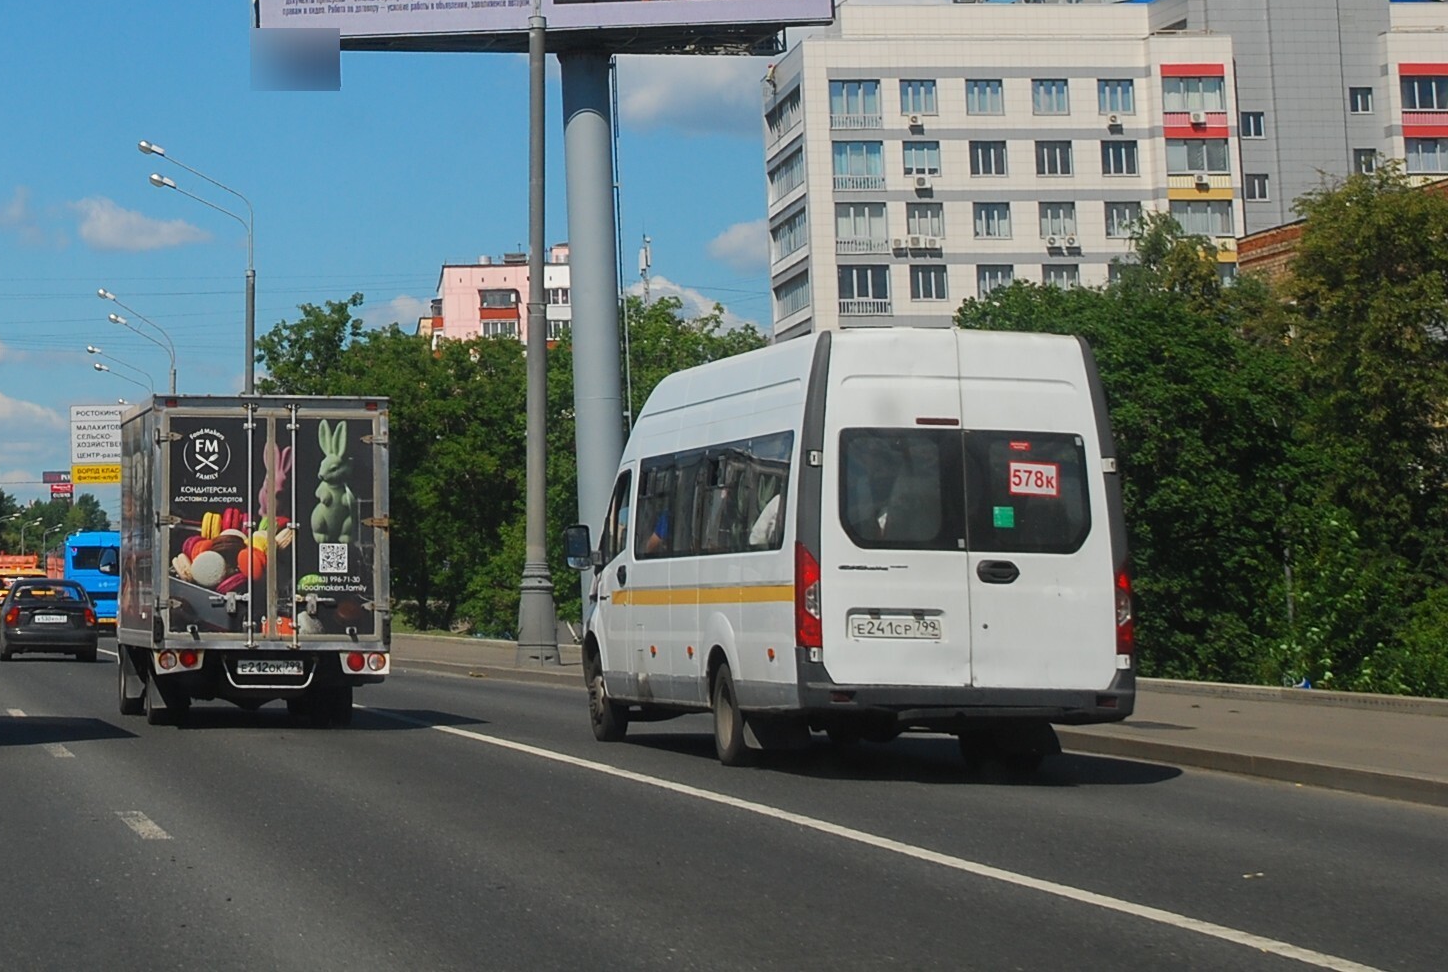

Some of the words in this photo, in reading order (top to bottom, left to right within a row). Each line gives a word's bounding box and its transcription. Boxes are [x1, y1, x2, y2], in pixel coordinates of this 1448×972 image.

[195, 439, 219, 453] FM
[195, 472, 219, 481] FAMILY
[180, 486, 237, 494] КОНДИТЕРСКАЯ
[329, 575, 361, 583] 996-71-30
